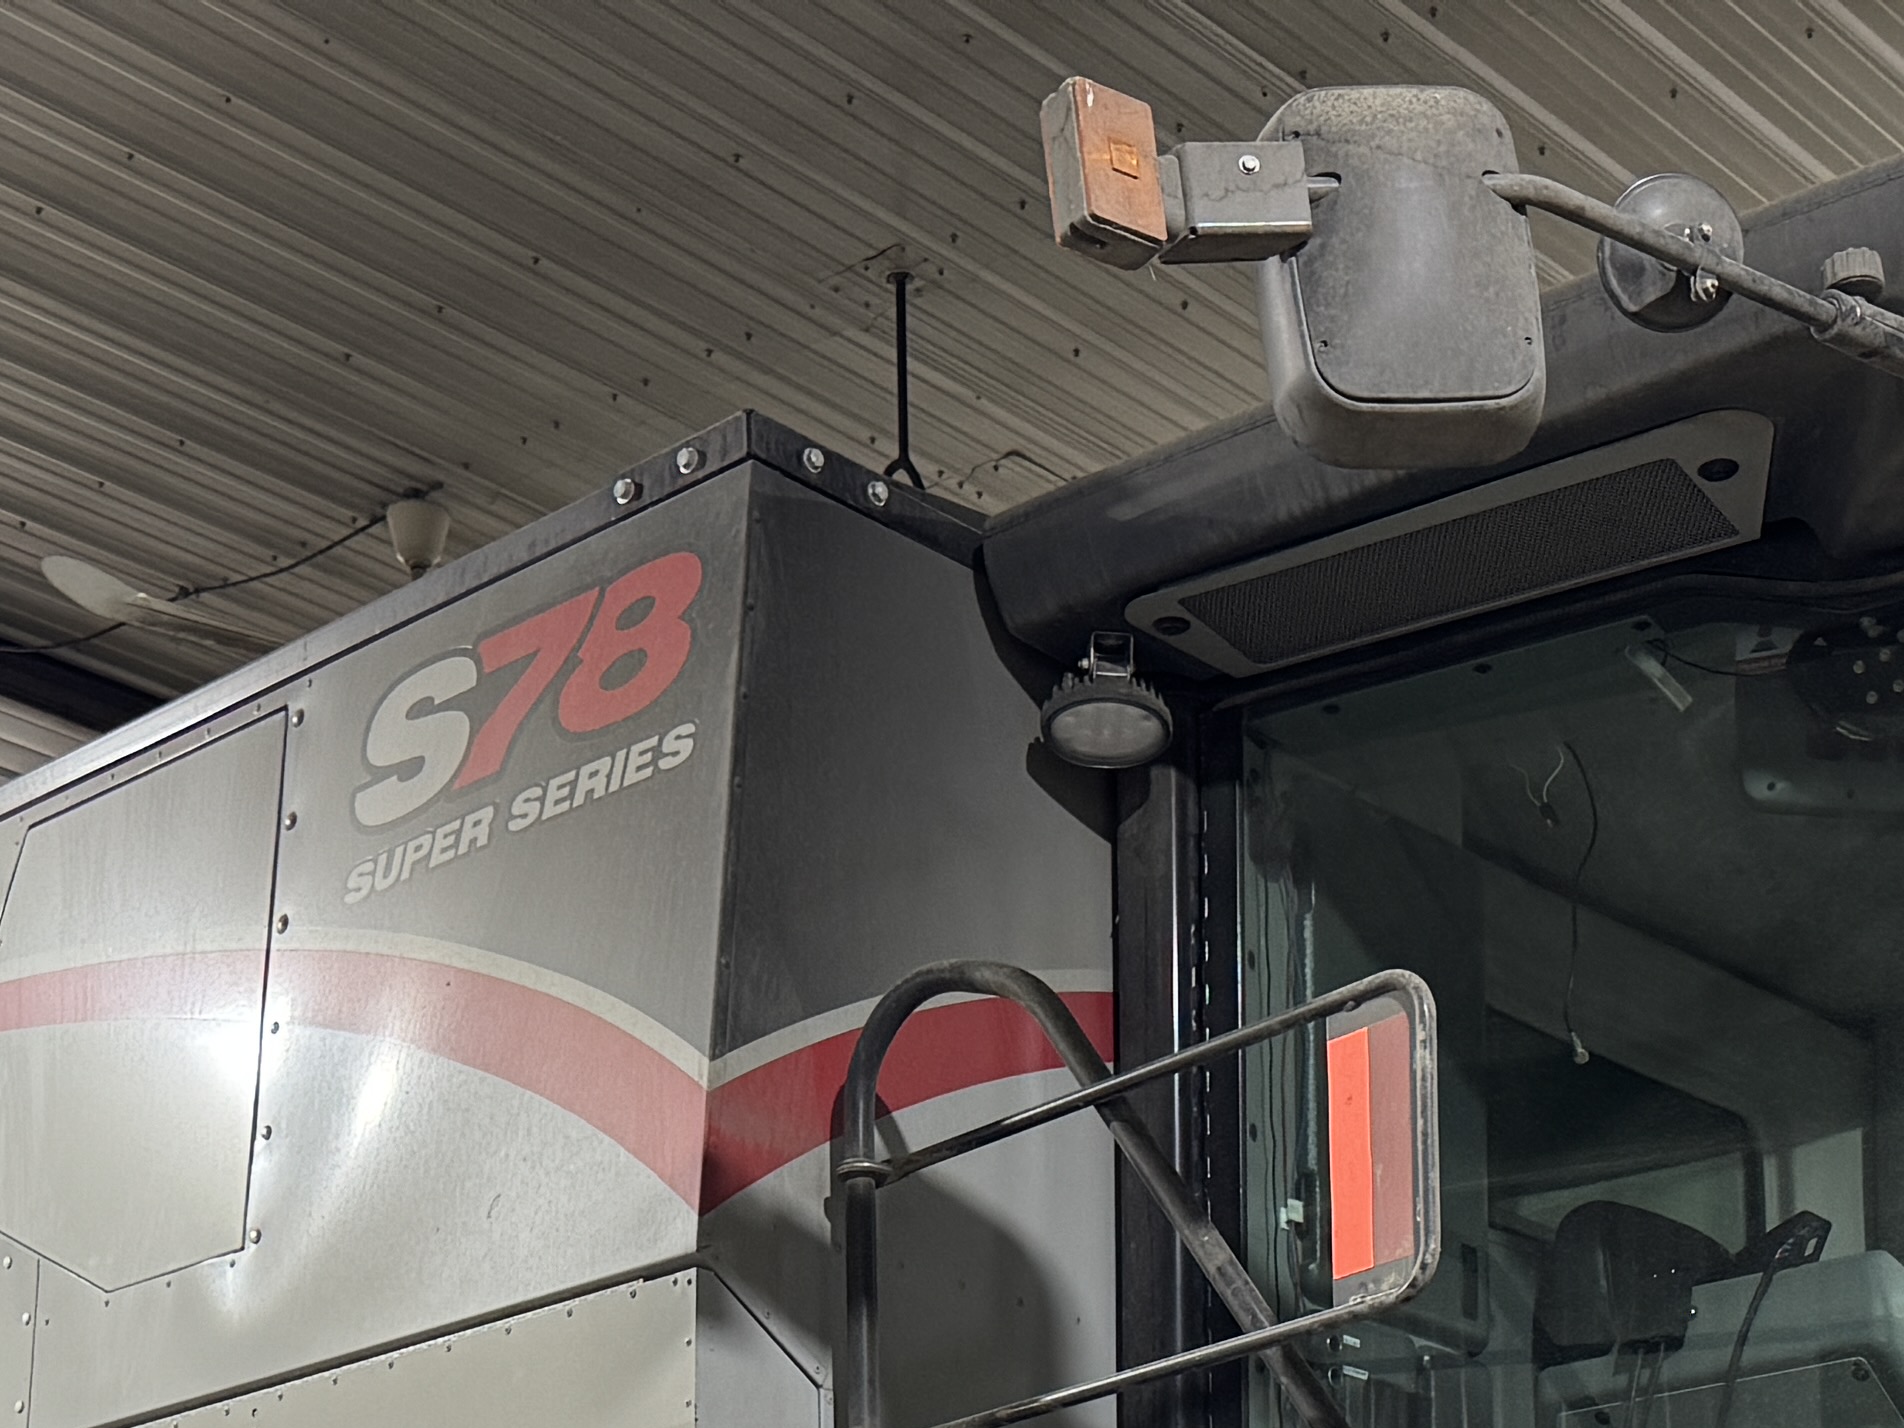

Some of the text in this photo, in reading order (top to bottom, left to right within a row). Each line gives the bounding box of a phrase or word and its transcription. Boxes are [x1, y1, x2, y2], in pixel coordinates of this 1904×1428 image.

[354, 551, 703, 827] S78
[343, 721, 696, 905] SUPER SERIES
